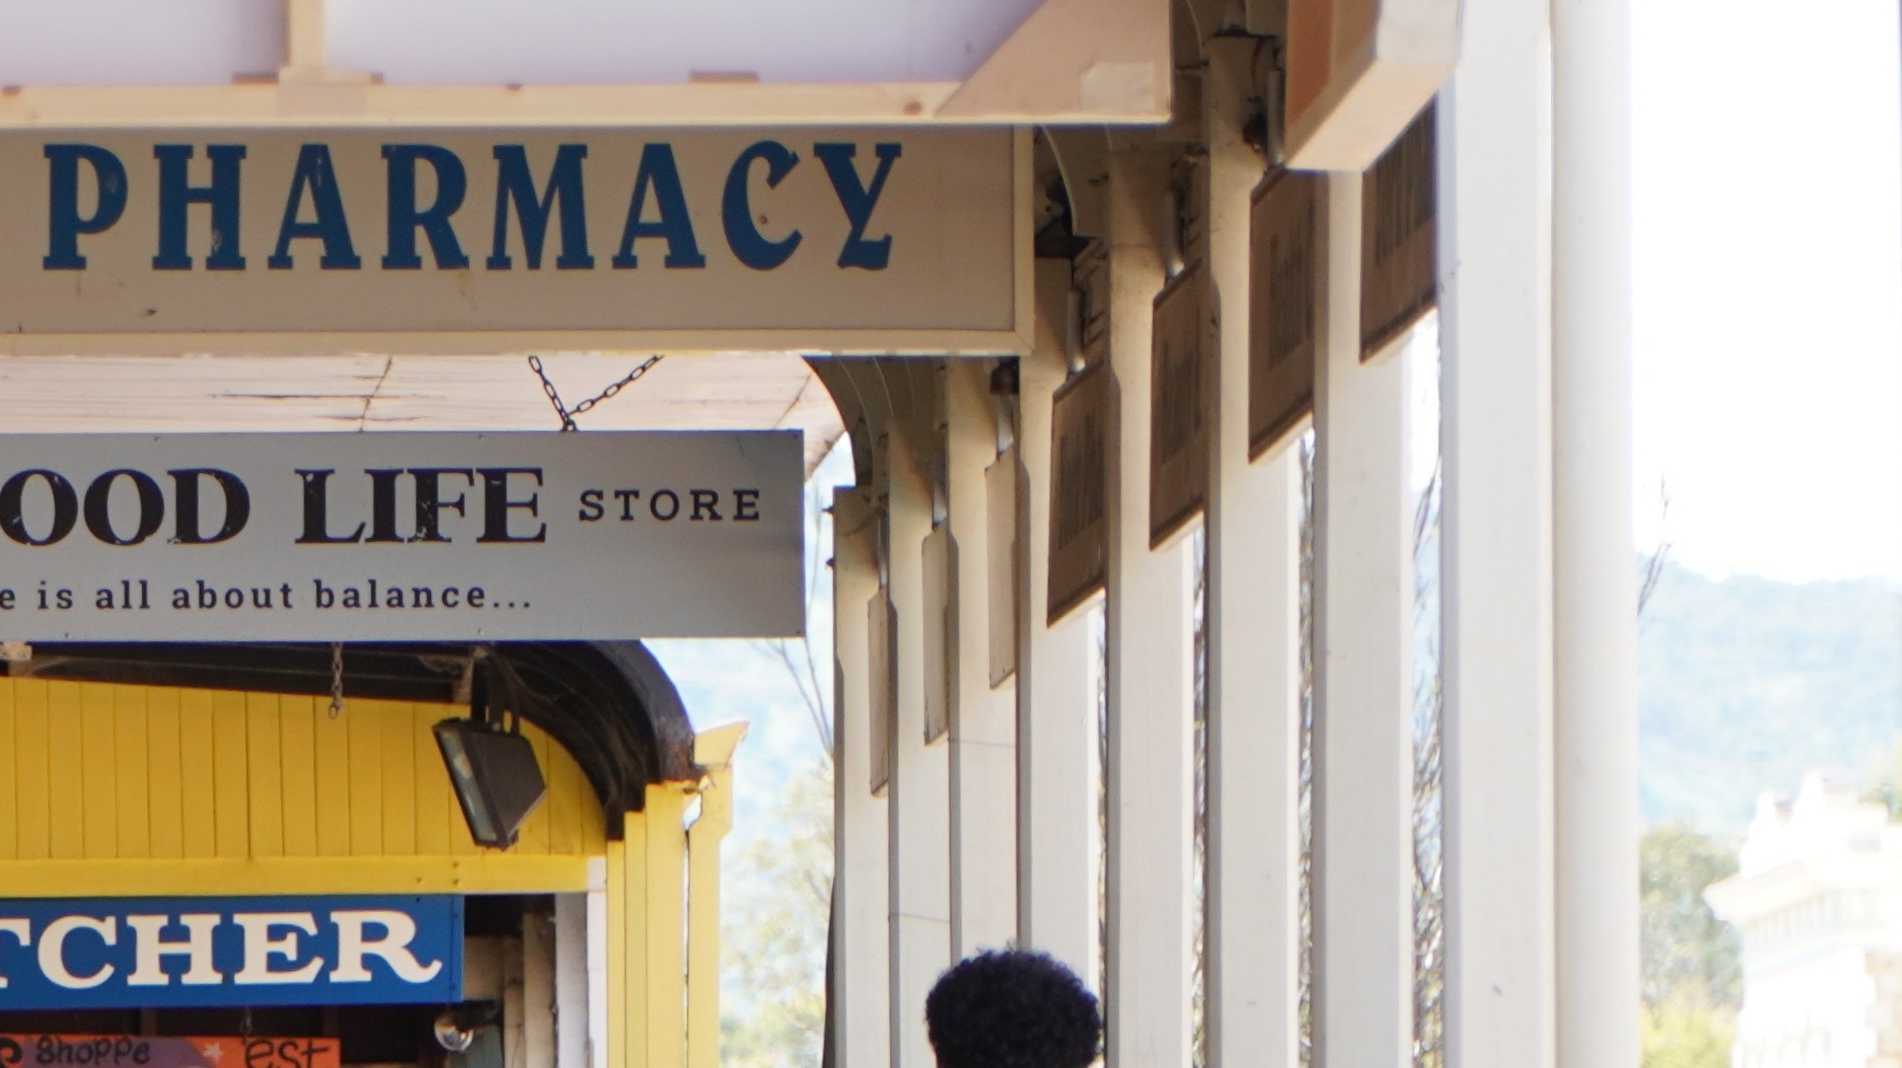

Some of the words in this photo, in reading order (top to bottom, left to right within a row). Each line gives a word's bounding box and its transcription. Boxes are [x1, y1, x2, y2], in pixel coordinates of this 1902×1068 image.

[42, 140, 902, 273] PHARMACY
[294, 466, 548, 545] LIFE
[578, 487, 762, 523] STORE
[37, 580, 74, 610] is
[95, 579, 152, 610] all
[171, 579, 295, 610] about
[313, 577, 534, 610] balance...
